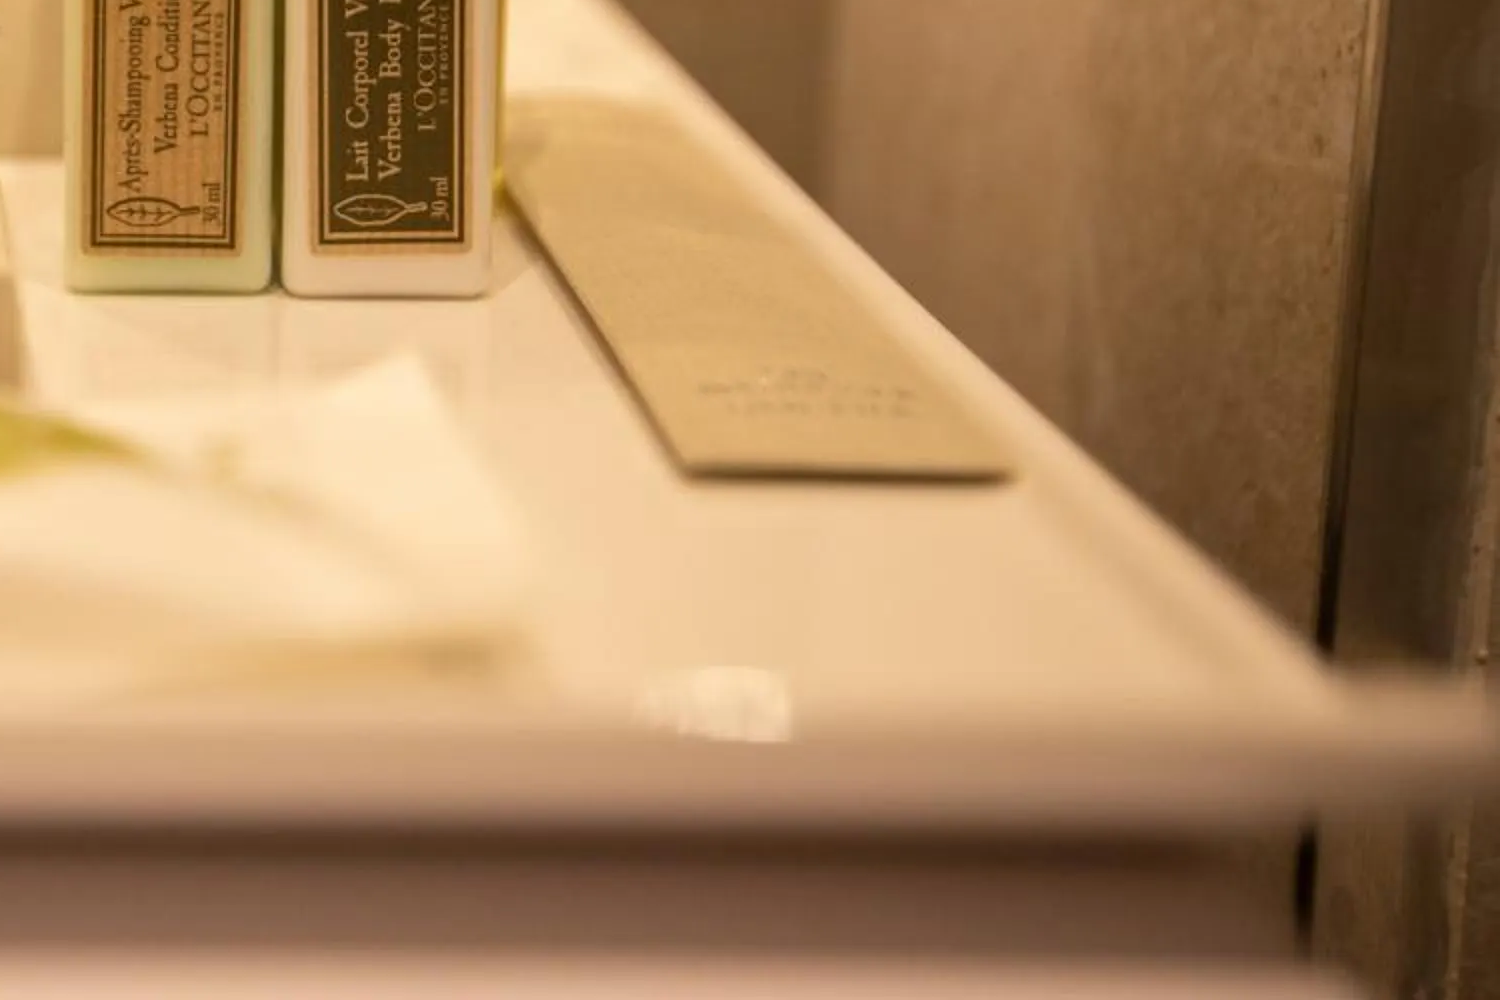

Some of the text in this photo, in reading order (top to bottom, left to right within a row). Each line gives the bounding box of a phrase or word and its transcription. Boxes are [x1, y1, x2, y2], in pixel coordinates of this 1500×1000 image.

[378, 18, 411, 78] Body
[345, 30, 376, 129] Corporel
[153, 83, 180, 154] Verbena
[377, 91, 402, 181] Verbena
[345, 139, 369, 182] Lait
[202, 182, 221, 223] 30 ml
[429, 177, 450, 221] 30 ml
